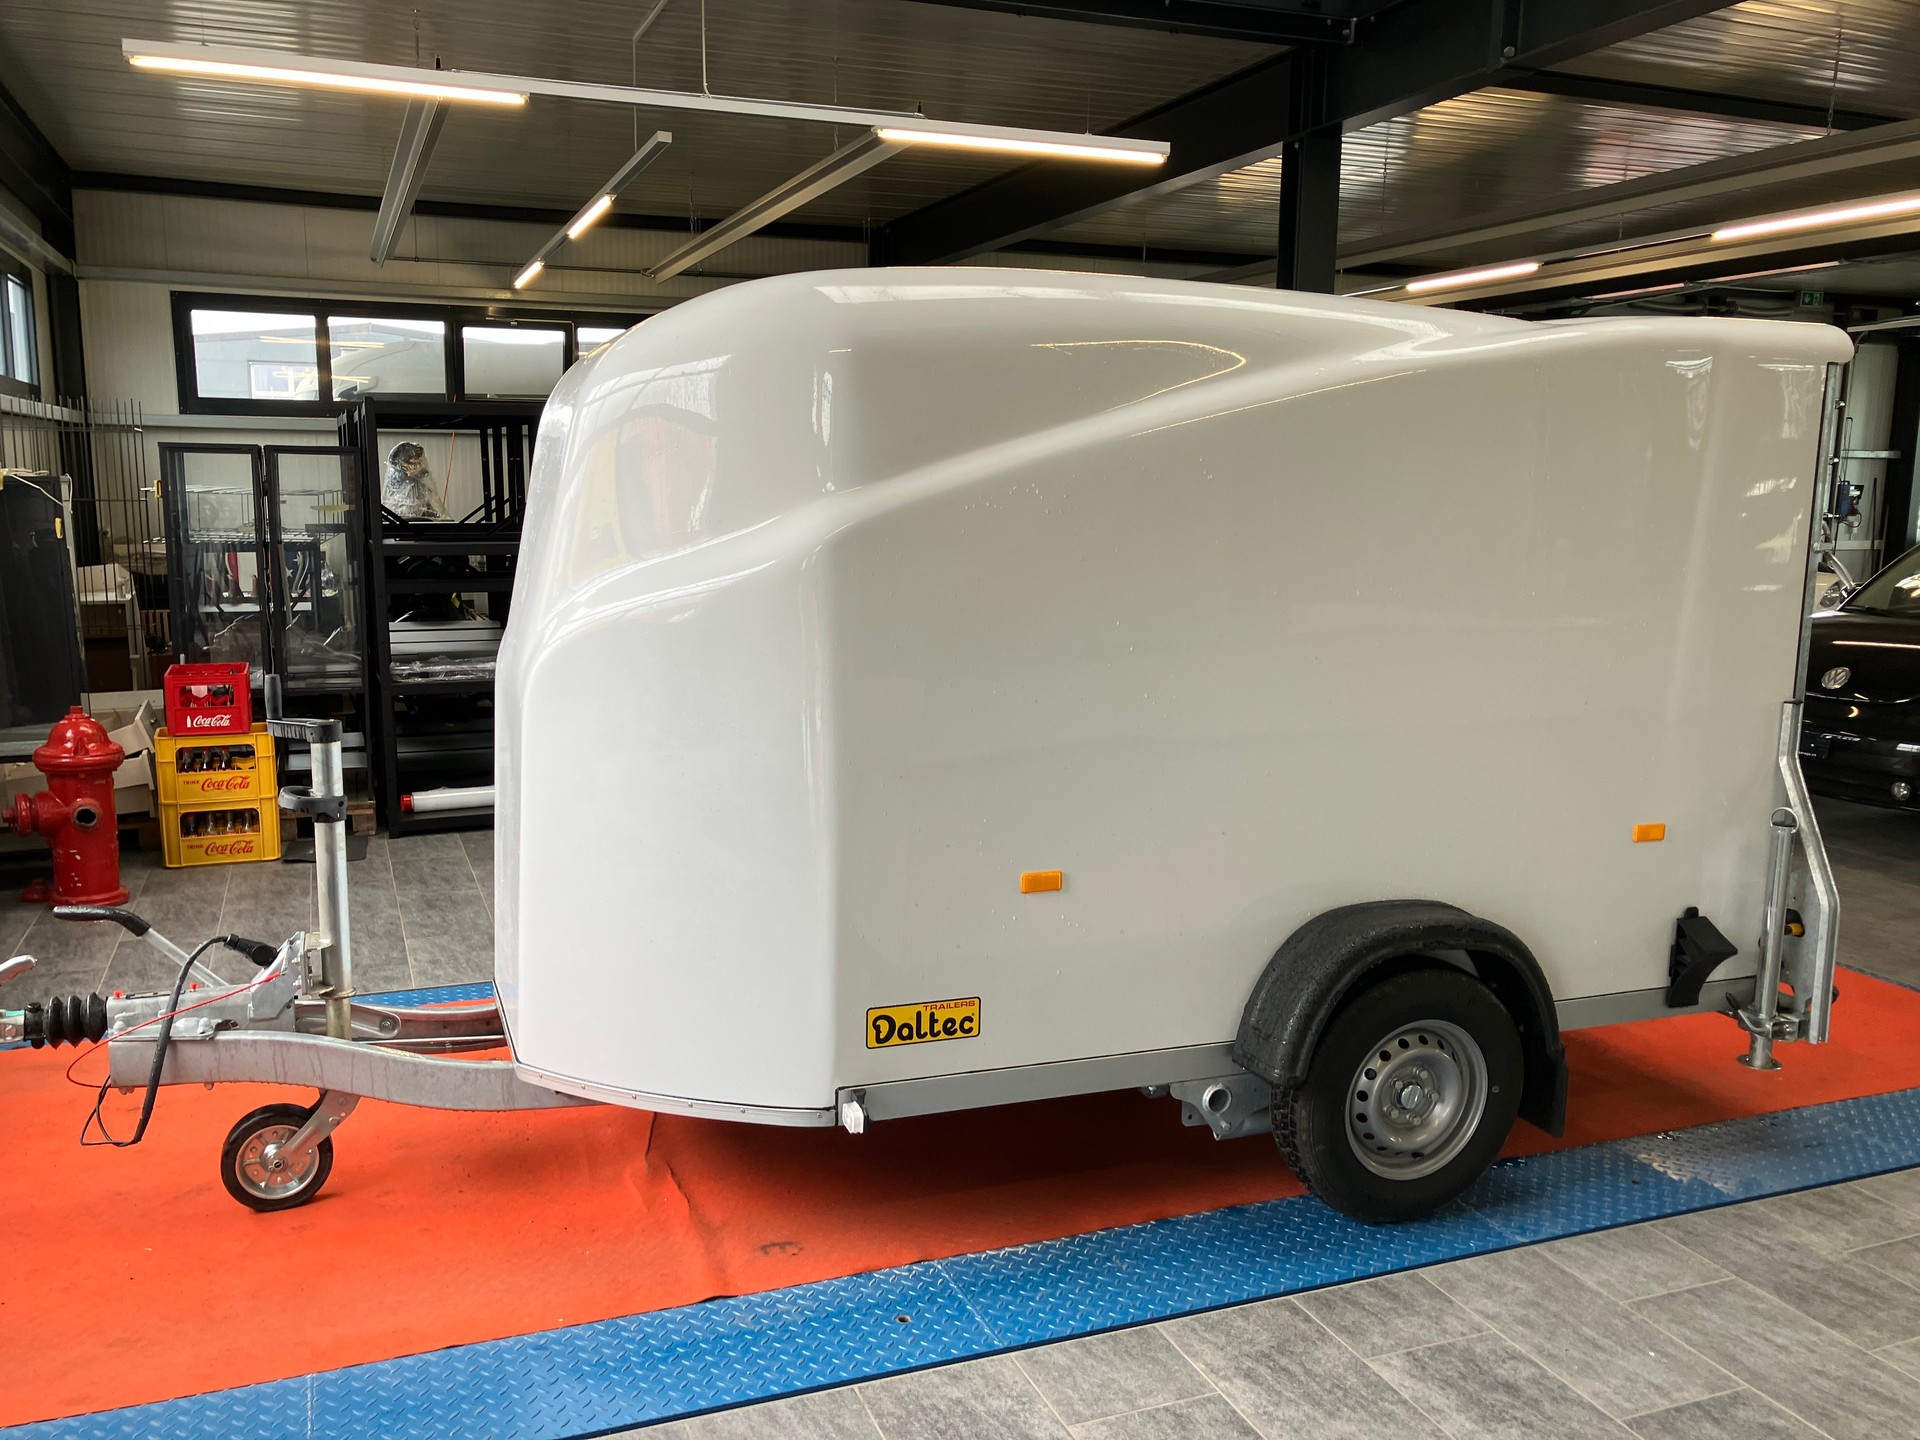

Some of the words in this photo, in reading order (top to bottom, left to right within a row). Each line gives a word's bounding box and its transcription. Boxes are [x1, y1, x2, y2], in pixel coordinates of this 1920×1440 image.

[193, 714, 232, 727] Coca-Cola
[201, 775, 251, 792] Coca-Cola
[205, 840, 254, 856] Coca-Cola
[923, 1000, 976, 1012] TRAILERS
[872, 1010, 975, 1044] Daltec
